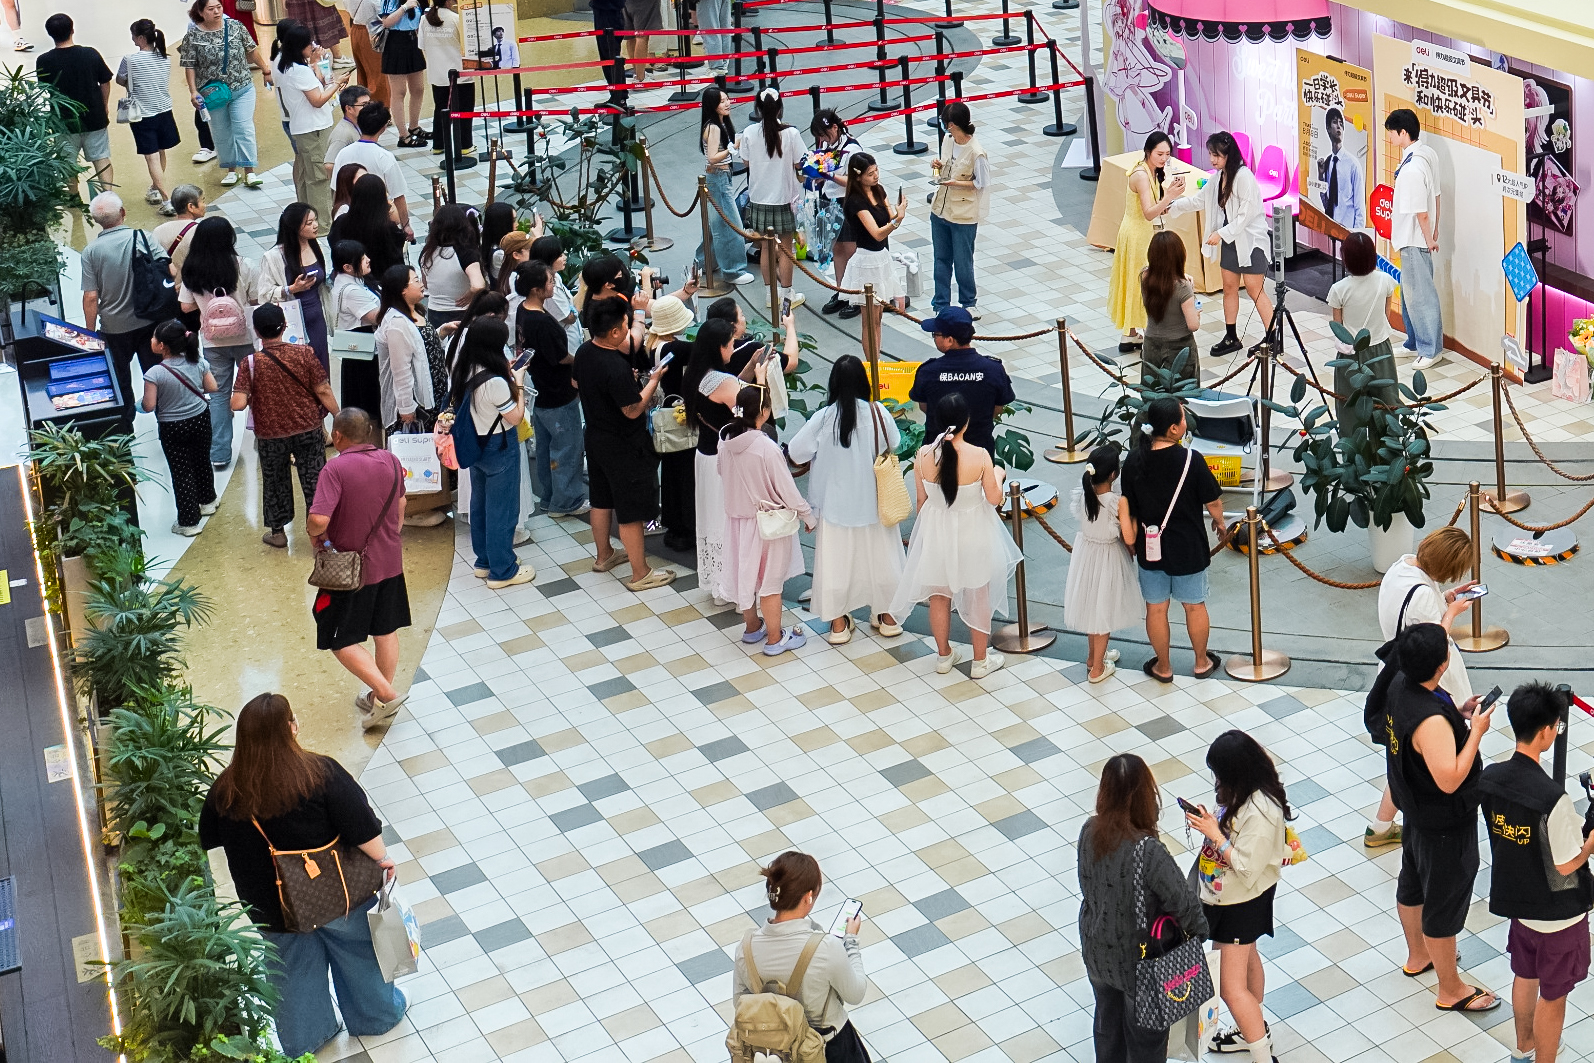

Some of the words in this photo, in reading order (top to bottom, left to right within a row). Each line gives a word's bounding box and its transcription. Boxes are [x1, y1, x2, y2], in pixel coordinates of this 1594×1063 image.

[1416, 46, 1430, 57] deli
[1303, 74, 1338, 92] 一日学长
[1303, 89, 1343, 108] 快乐碰头
[1415, 92, 1484, 127] 和快乐碰头
[1184, 110, 1195, 126] deli
[1379, 198, 1393, 210] del
[939, 371, 984, 382] 保BAOAN安
